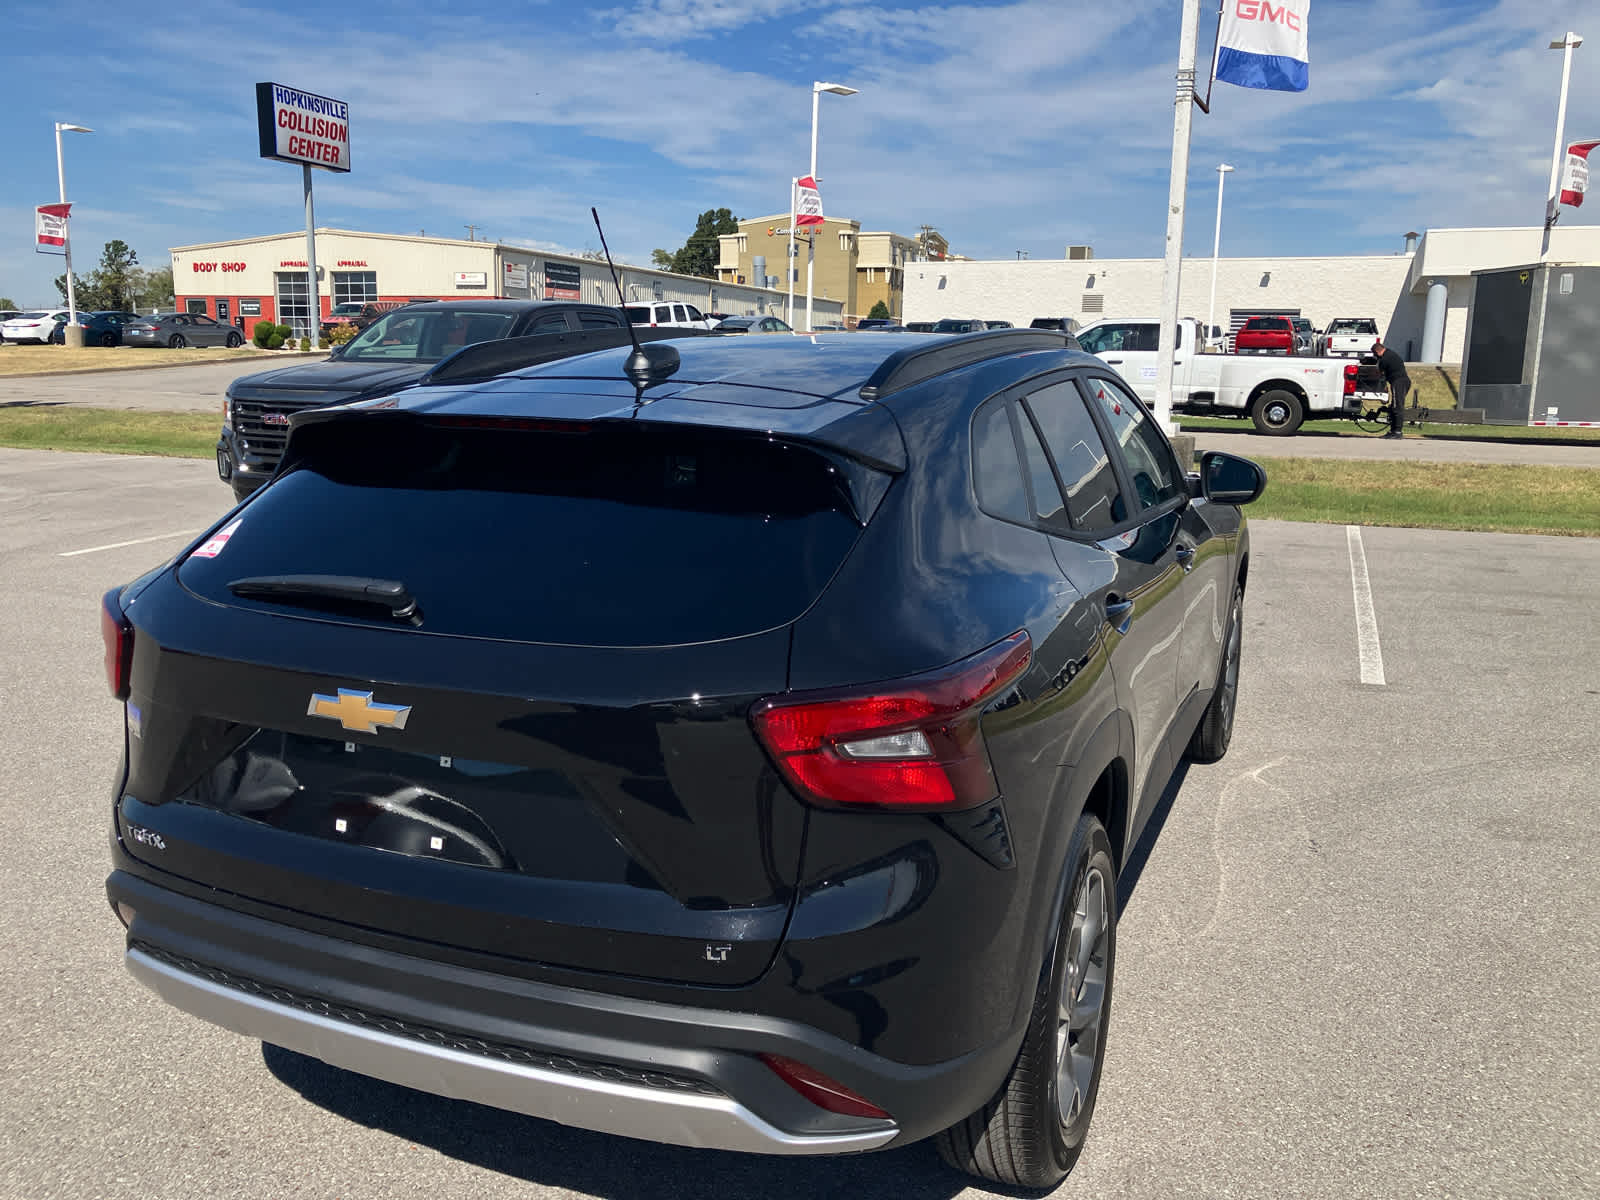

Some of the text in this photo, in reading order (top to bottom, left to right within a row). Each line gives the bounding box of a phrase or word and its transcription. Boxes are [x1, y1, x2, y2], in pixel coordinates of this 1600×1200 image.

[1236, 0, 1301, 32] GMC
[275, 86, 347, 120] HOPKINSVILLE
[278, 108, 347, 143] COLLISION
[288, 135, 340, 163] CENTER
[193, 262, 247, 273] BODY SHOP
[264, 413, 289, 426] GM
[706, 944, 732, 961] LT
